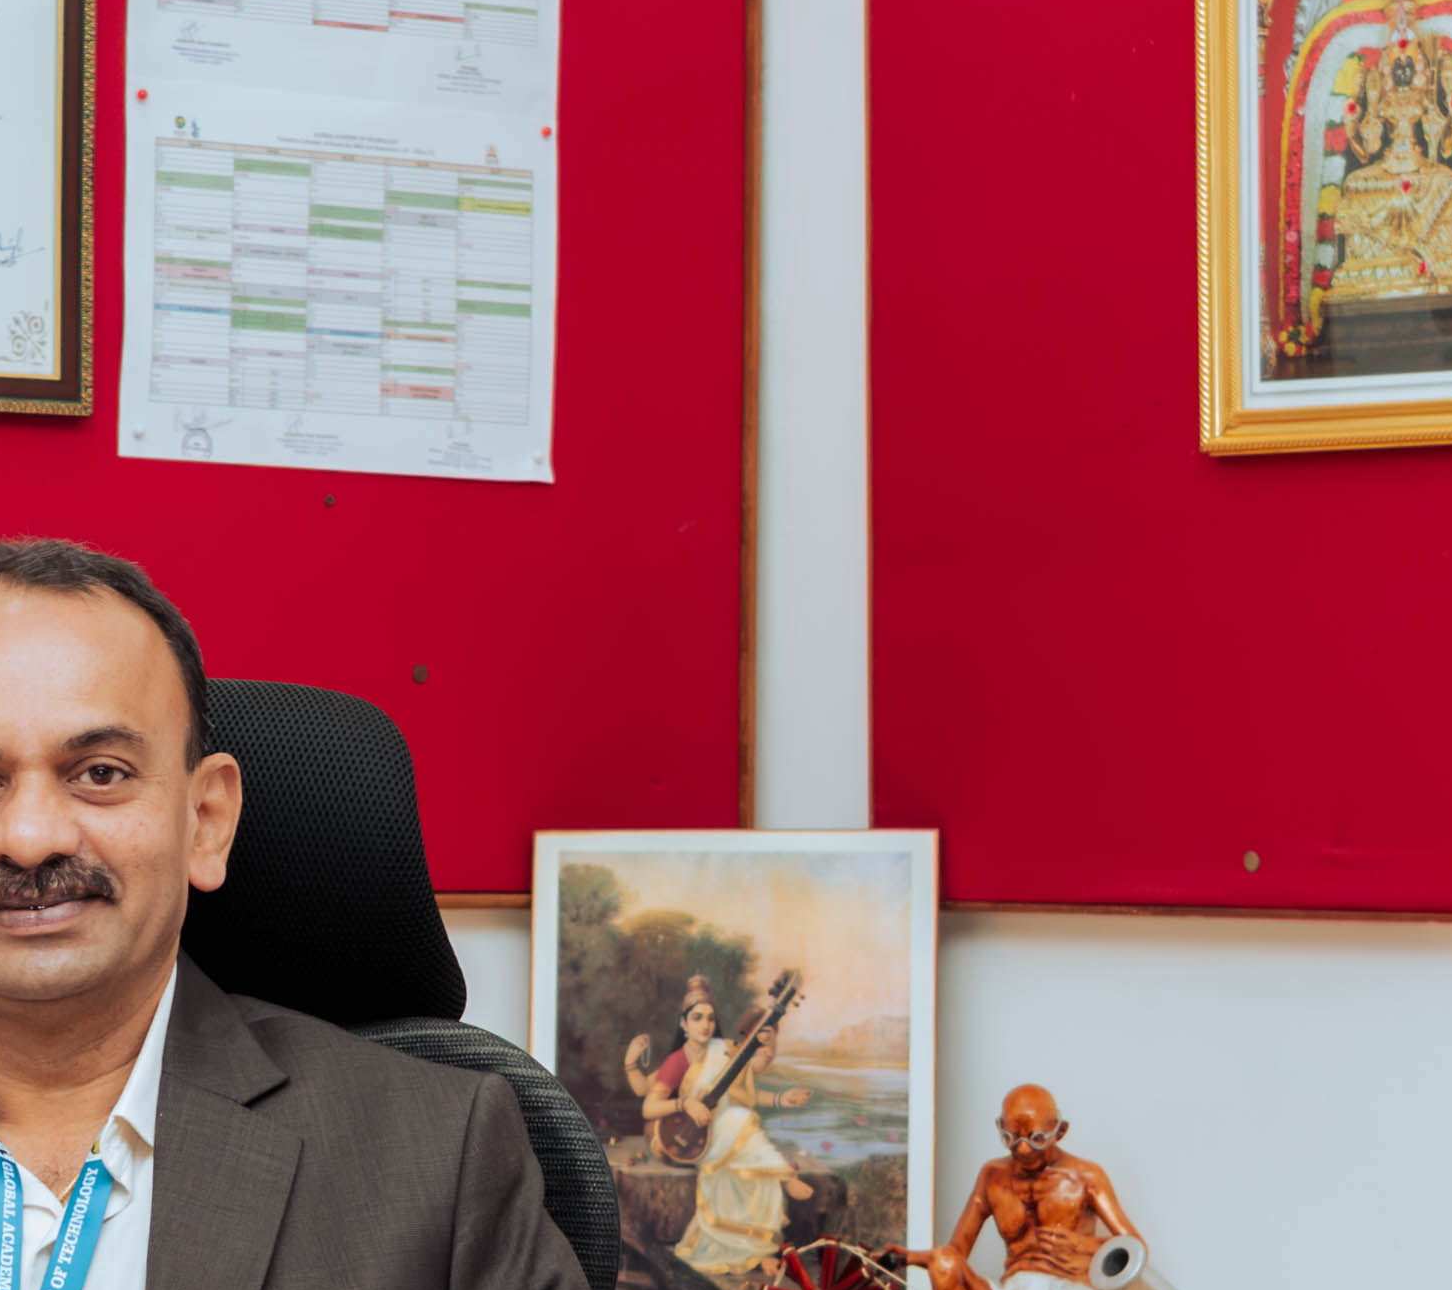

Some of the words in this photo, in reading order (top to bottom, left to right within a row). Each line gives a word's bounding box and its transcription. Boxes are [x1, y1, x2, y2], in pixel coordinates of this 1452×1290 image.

[2, 1160, 17, 1223] GLOBAL
[58, 1166, 99, 1265] TECHNOLOGY
[51, 1265, 68, 1290] OF
